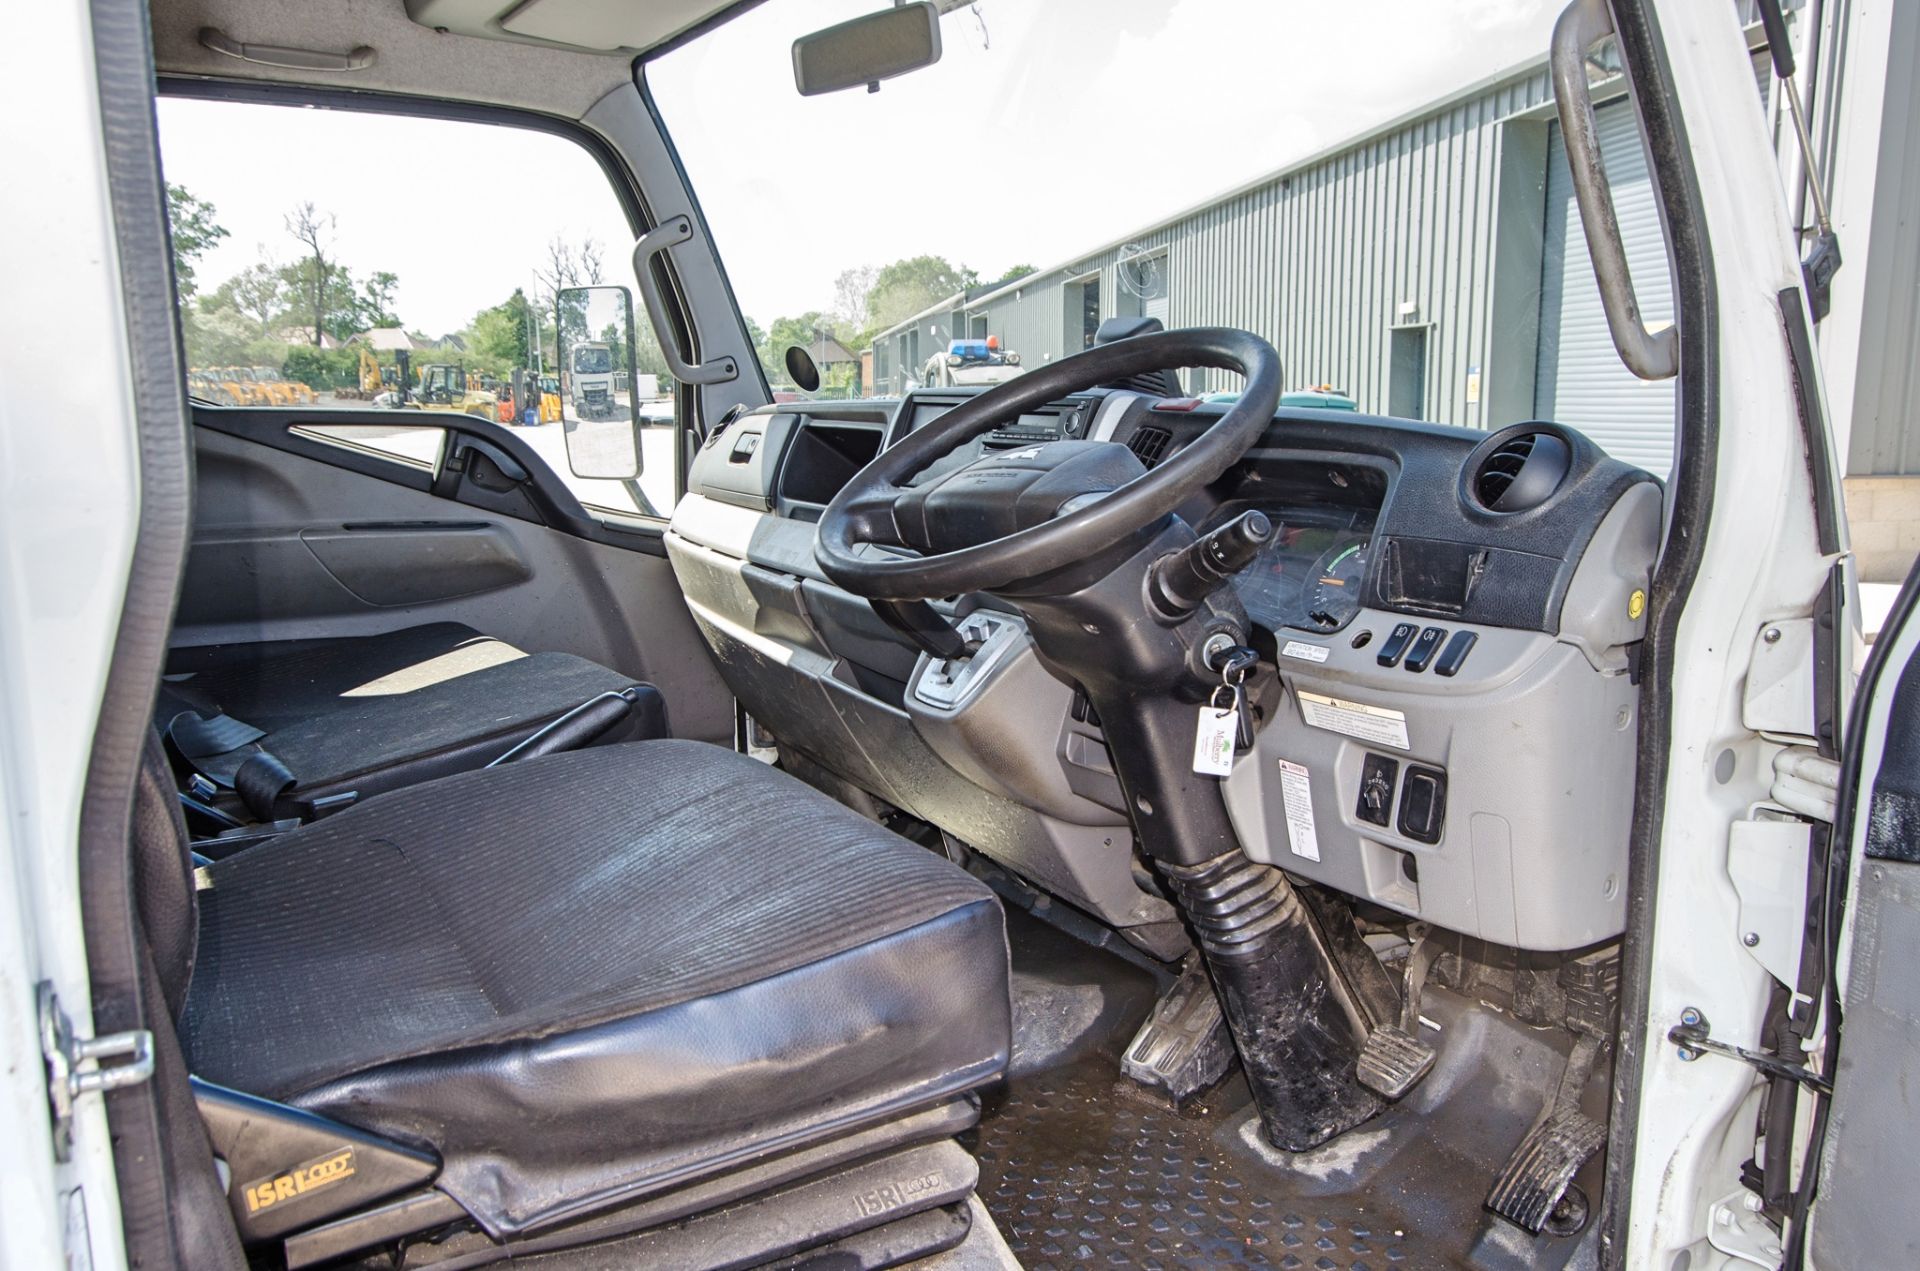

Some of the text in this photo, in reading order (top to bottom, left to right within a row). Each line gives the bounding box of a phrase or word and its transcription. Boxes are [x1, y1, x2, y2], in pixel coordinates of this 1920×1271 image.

[1213, 730, 1225, 764] Mulberry
[247, 1170, 306, 1212] ISRI
[853, 1183, 906, 1216] ISRI
